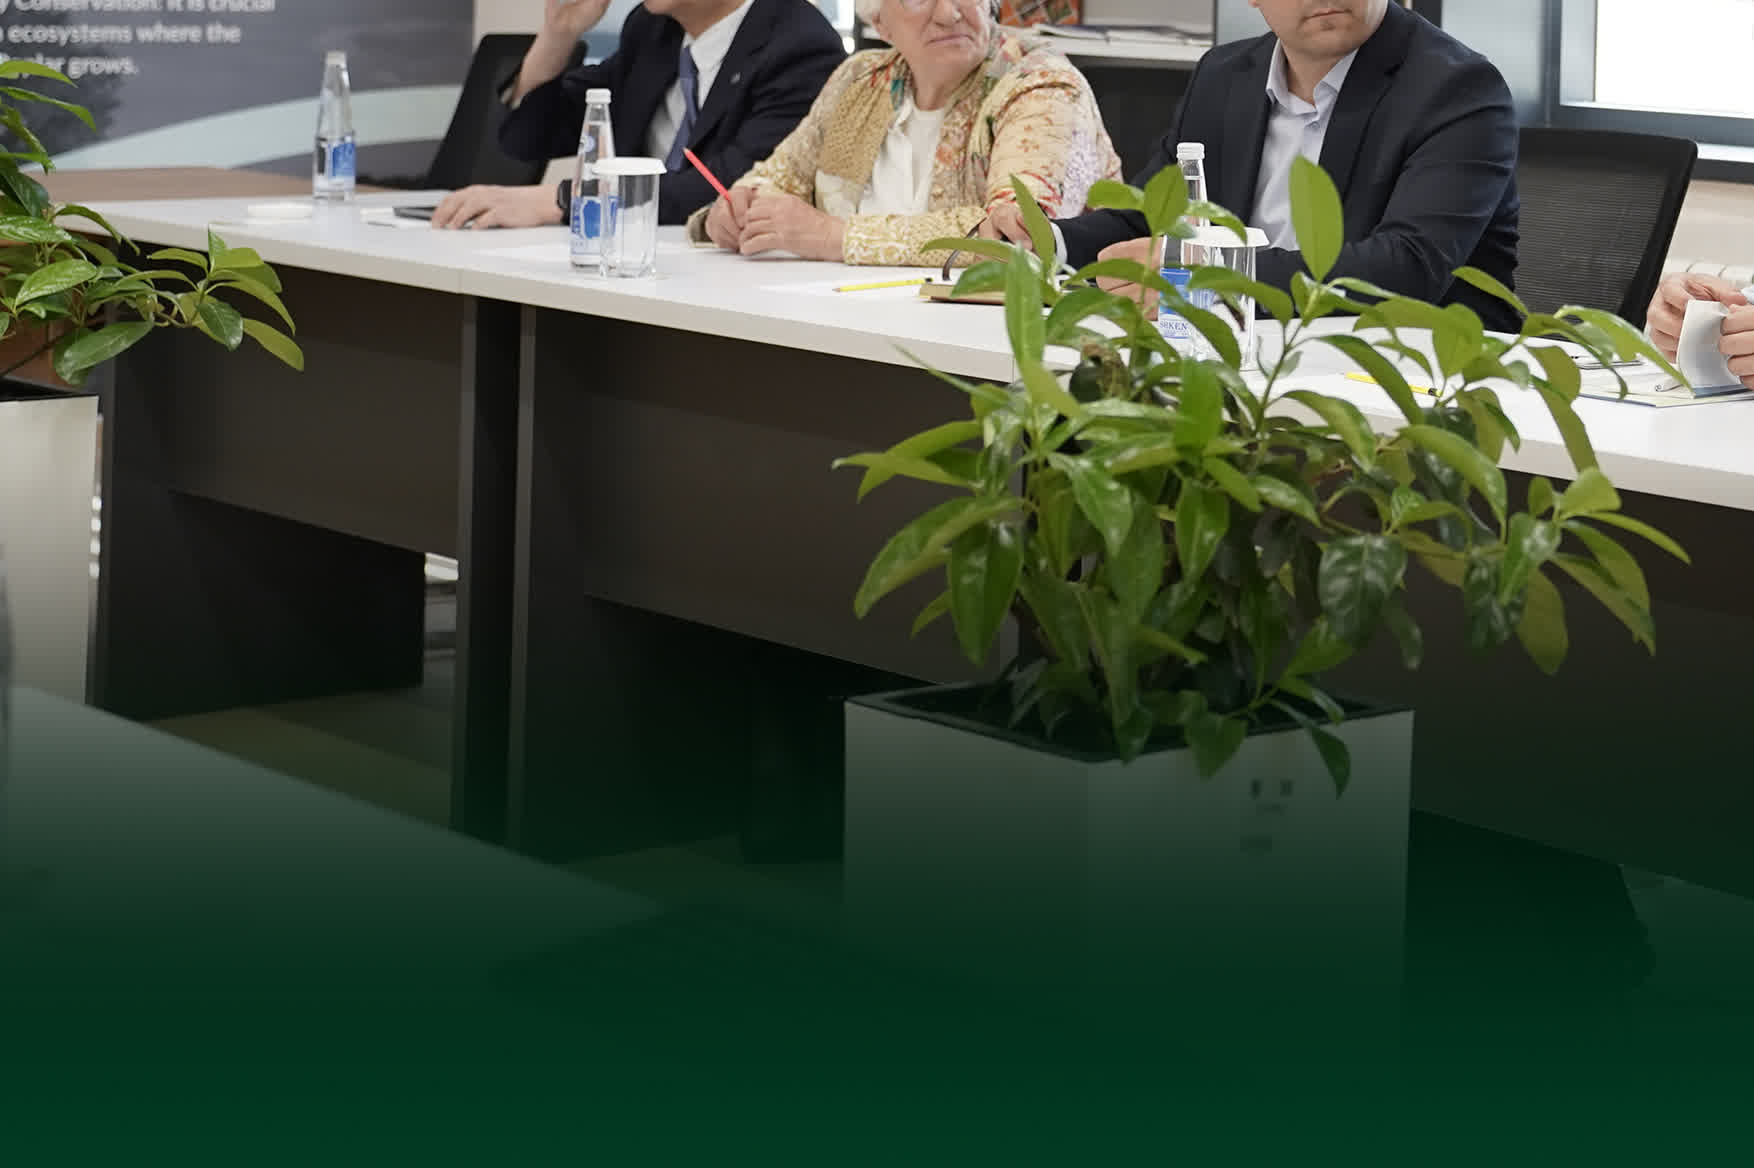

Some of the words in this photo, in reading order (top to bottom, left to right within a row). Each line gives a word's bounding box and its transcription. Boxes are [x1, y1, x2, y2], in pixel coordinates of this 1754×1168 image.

[7, 23, 133, 47] ecosystems
[136, 21, 202, 43] where
[206, 21, 241, 43] the
[67, 55, 138, 80] grows.
